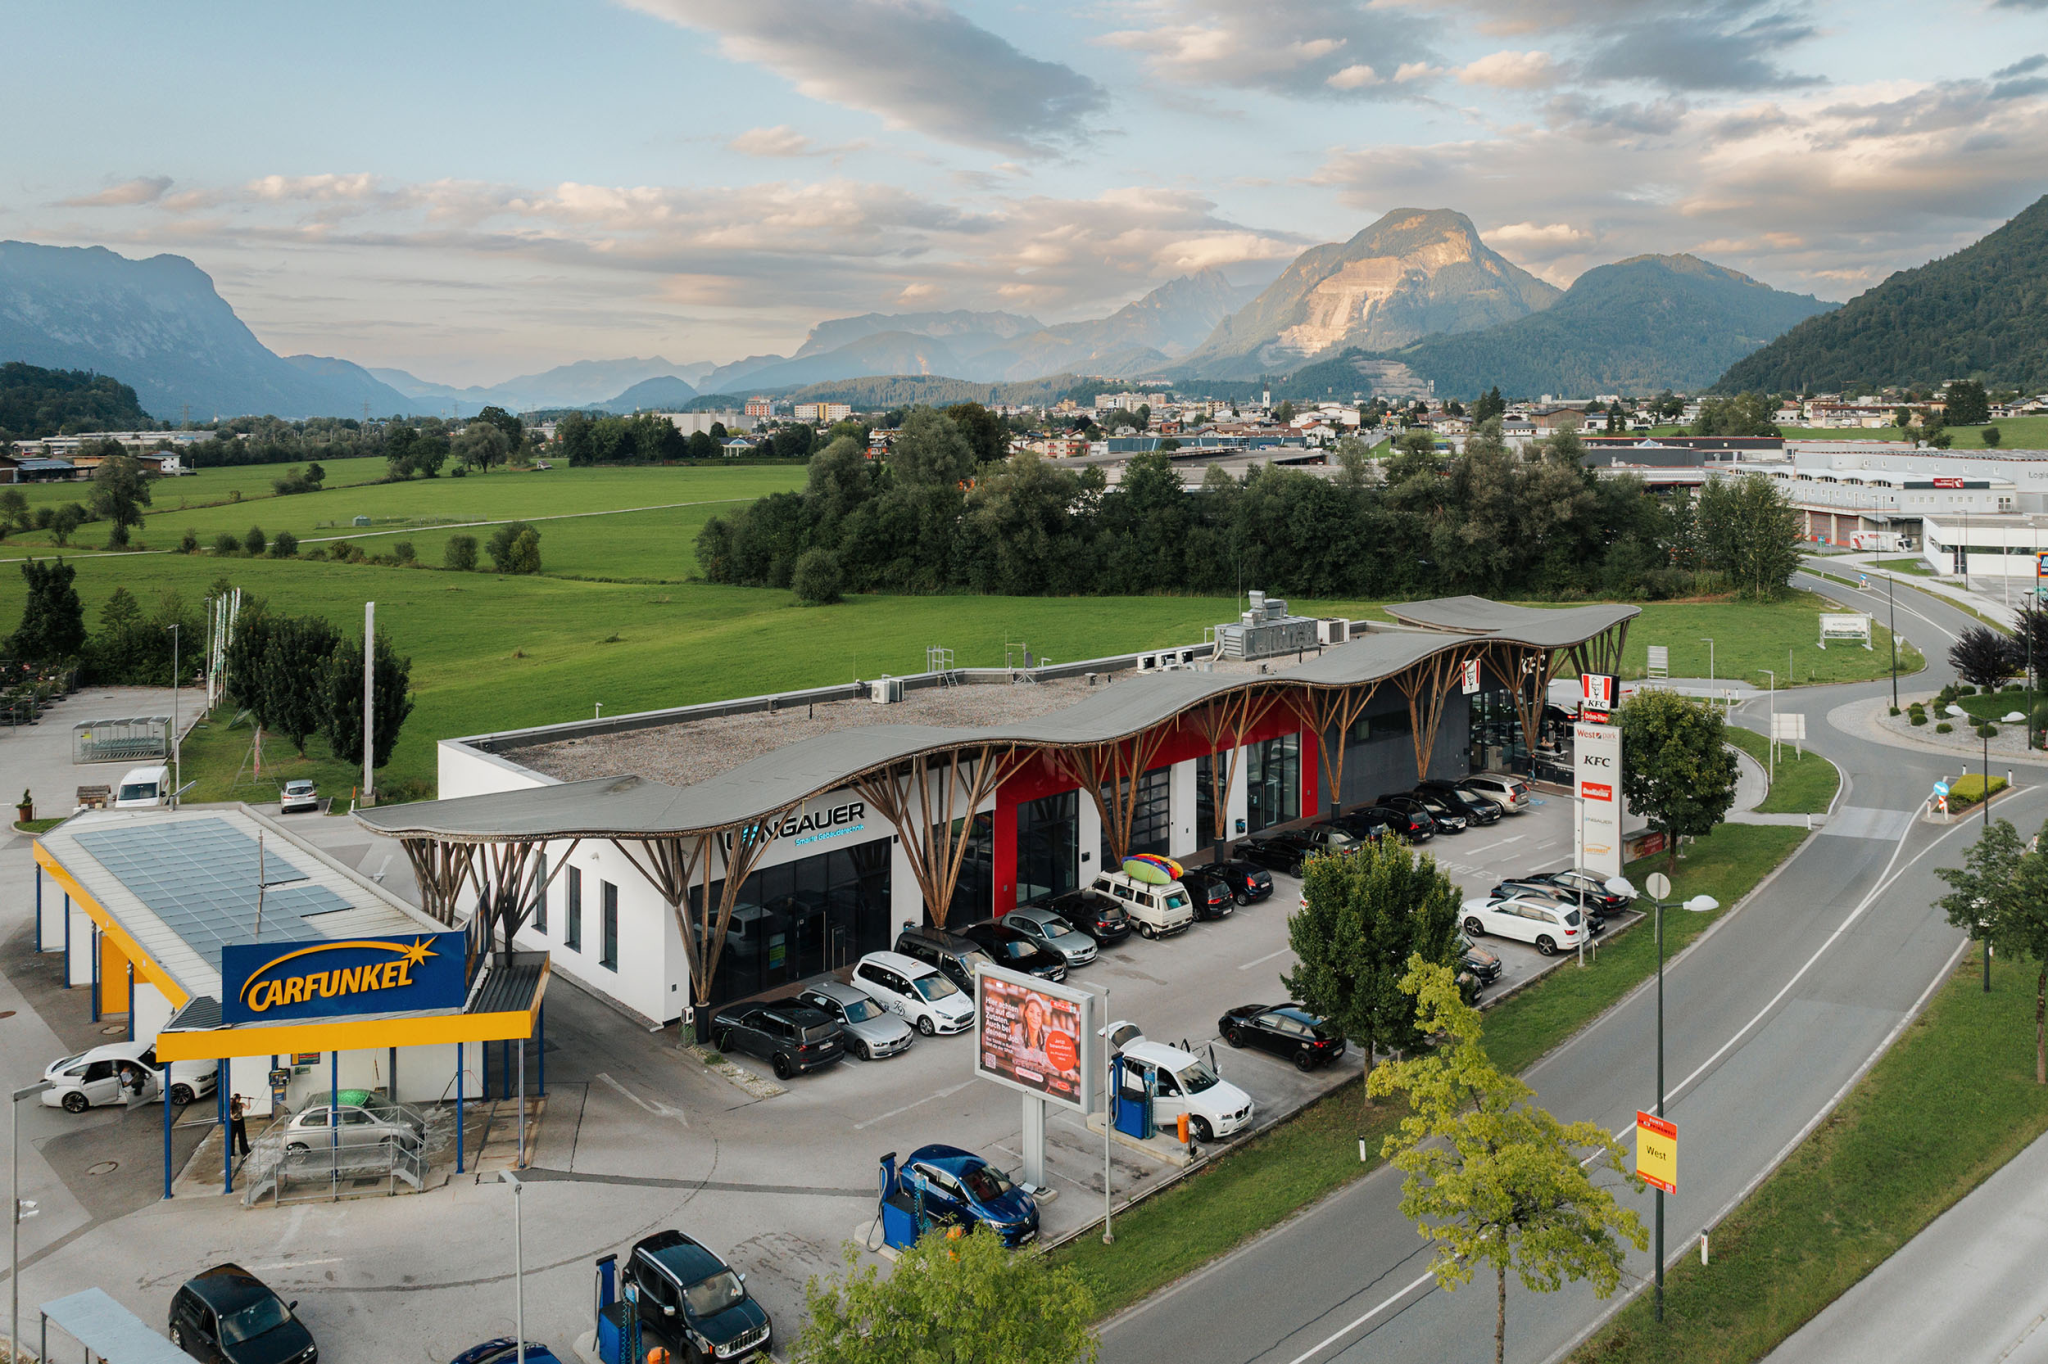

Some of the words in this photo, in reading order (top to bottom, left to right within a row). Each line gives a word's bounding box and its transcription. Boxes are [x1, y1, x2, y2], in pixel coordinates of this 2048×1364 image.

[1588, 700, 1606, 708] KFC
[1577, 729, 1595, 739] West
[1602, 732, 1616, 740] park
[1584, 755, 1611, 767] KFC
[795, 836, 818, 846] Smarte
[248, 959, 413, 1012] CARFUNKEL
[986, 996, 998, 1006] Hier
[998, 1001, 1019, 1013] achten
[986, 1019, 1001, 1029] Auch
[1646, 1145, 1666, 1161] West
